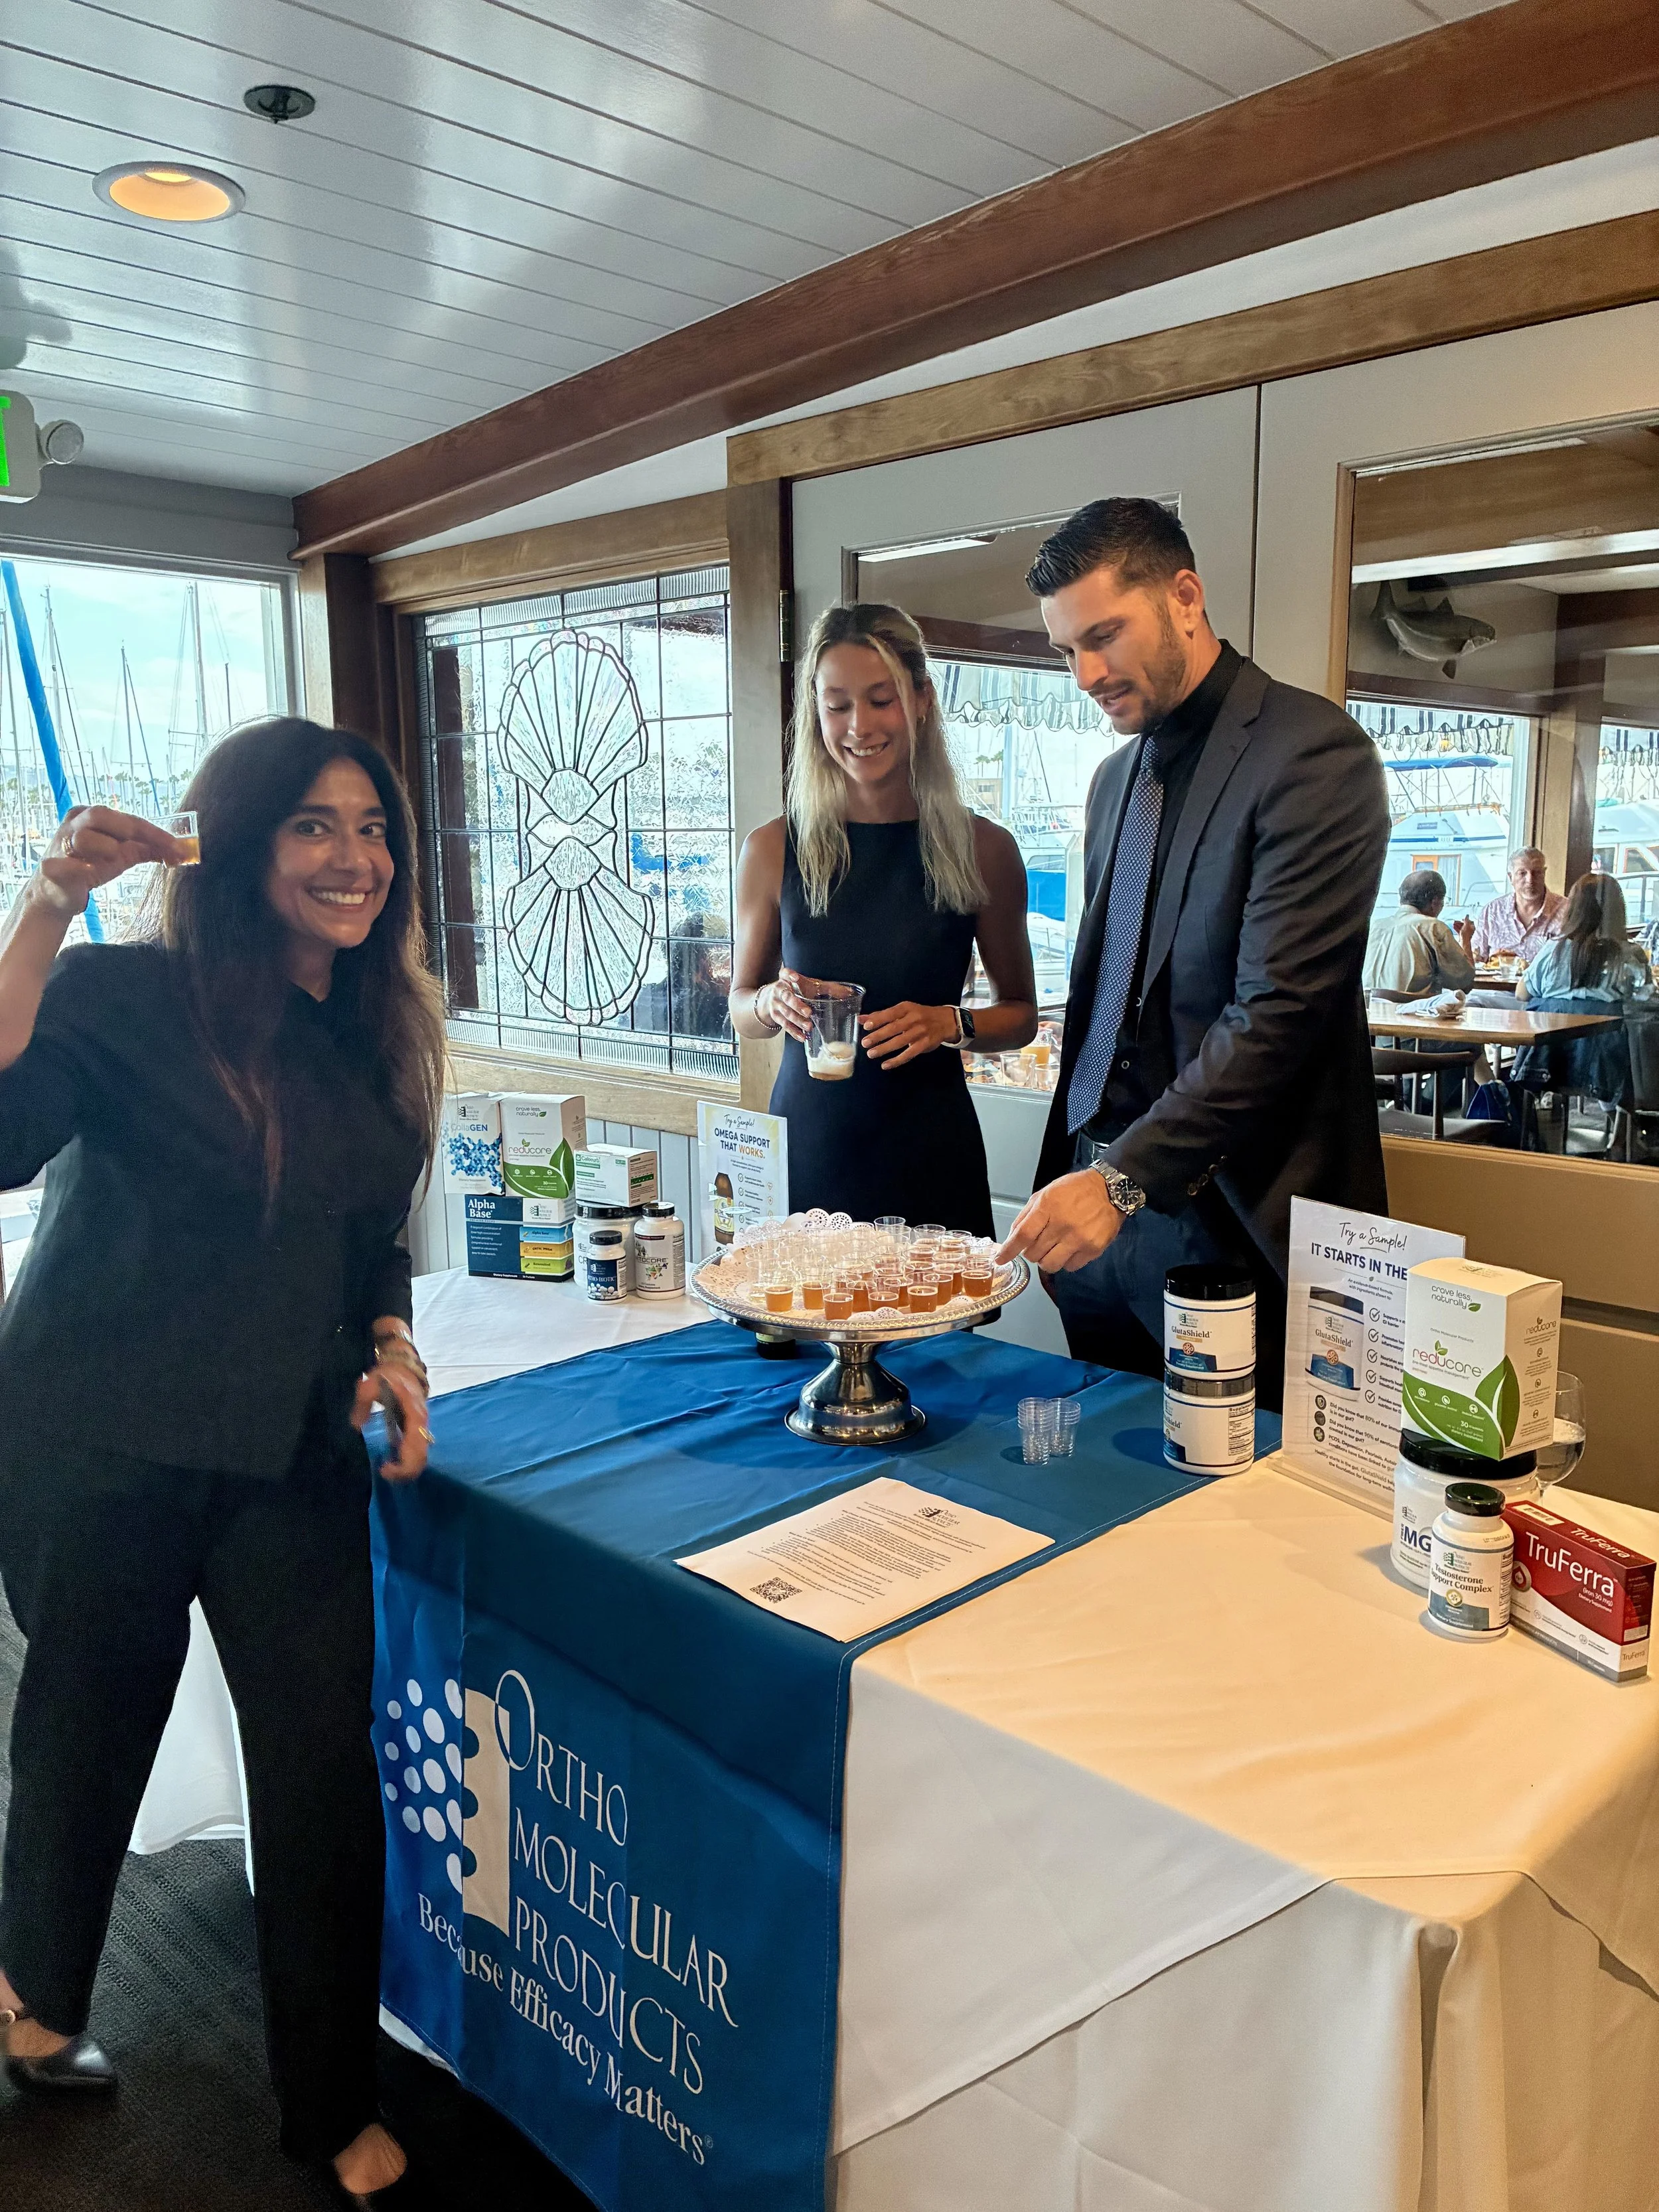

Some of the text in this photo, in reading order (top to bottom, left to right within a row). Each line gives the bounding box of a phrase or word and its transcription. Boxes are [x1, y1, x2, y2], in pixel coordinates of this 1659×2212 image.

[714, 1128, 770, 1149] OMEGA SUPPORT
[720, 1140, 765, 1159] THAT WORKS.
[468, 1199, 496, 1211] Alpha
[469, 1209, 492, 1218] Base
[1339, 1222, 1356, 1245] Try
[1368, 1227, 1407, 1252] Sample!
[1311, 1242, 1407, 1281] IT STARTS IN THE
[1431, 1285, 1473, 1301] crave less,
[1431, 1294, 1467, 1310] naturally
[1171, 1326, 1210, 1338] GlutaShield
[1412, 1348, 1482, 1377] reducore
[1571, 1528, 1630, 1558] TruFerra
[1435, 1563, 1483, 1584] Testosterone
[1526, 1531, 1614, 1598] TruFerra
[1455, 1582, 1492, 1593] Complex
[1595, 1593, 1602, 1601] 30
[1602, 1596, 1613, 1607] mg)
[495, 1670, 628, 1846] ORTHO
[514, 1806, 739, 2028] MOLECULAR
[417, 1893, 504, 1992] Because
[510, 1966, 602, 2086] Efficacy
[516, 1895, 703, 2095] PRODUCTS
